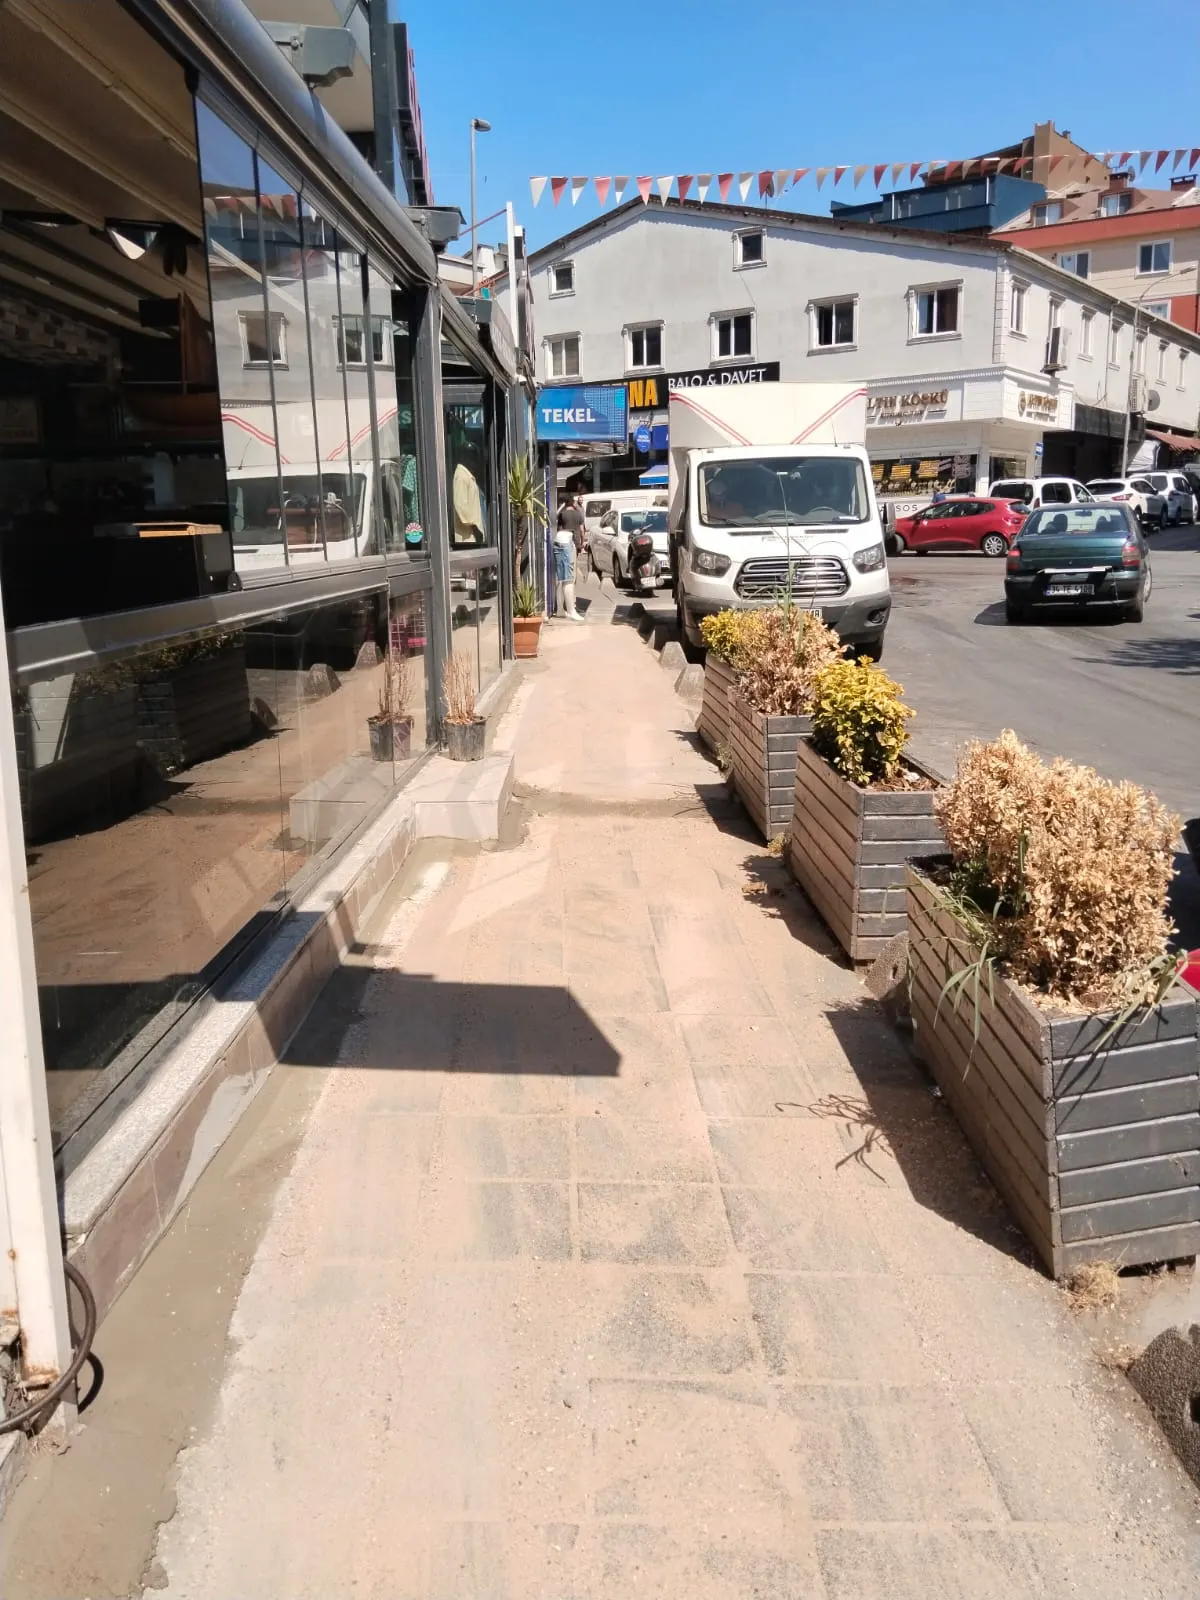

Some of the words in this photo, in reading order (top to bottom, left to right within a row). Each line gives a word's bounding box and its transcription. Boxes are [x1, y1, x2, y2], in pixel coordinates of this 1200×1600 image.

[721, 368, 767, 385] DAVET
[629, 379, 659, 408] NA
[542, 408, 596, 423] TEKEL
